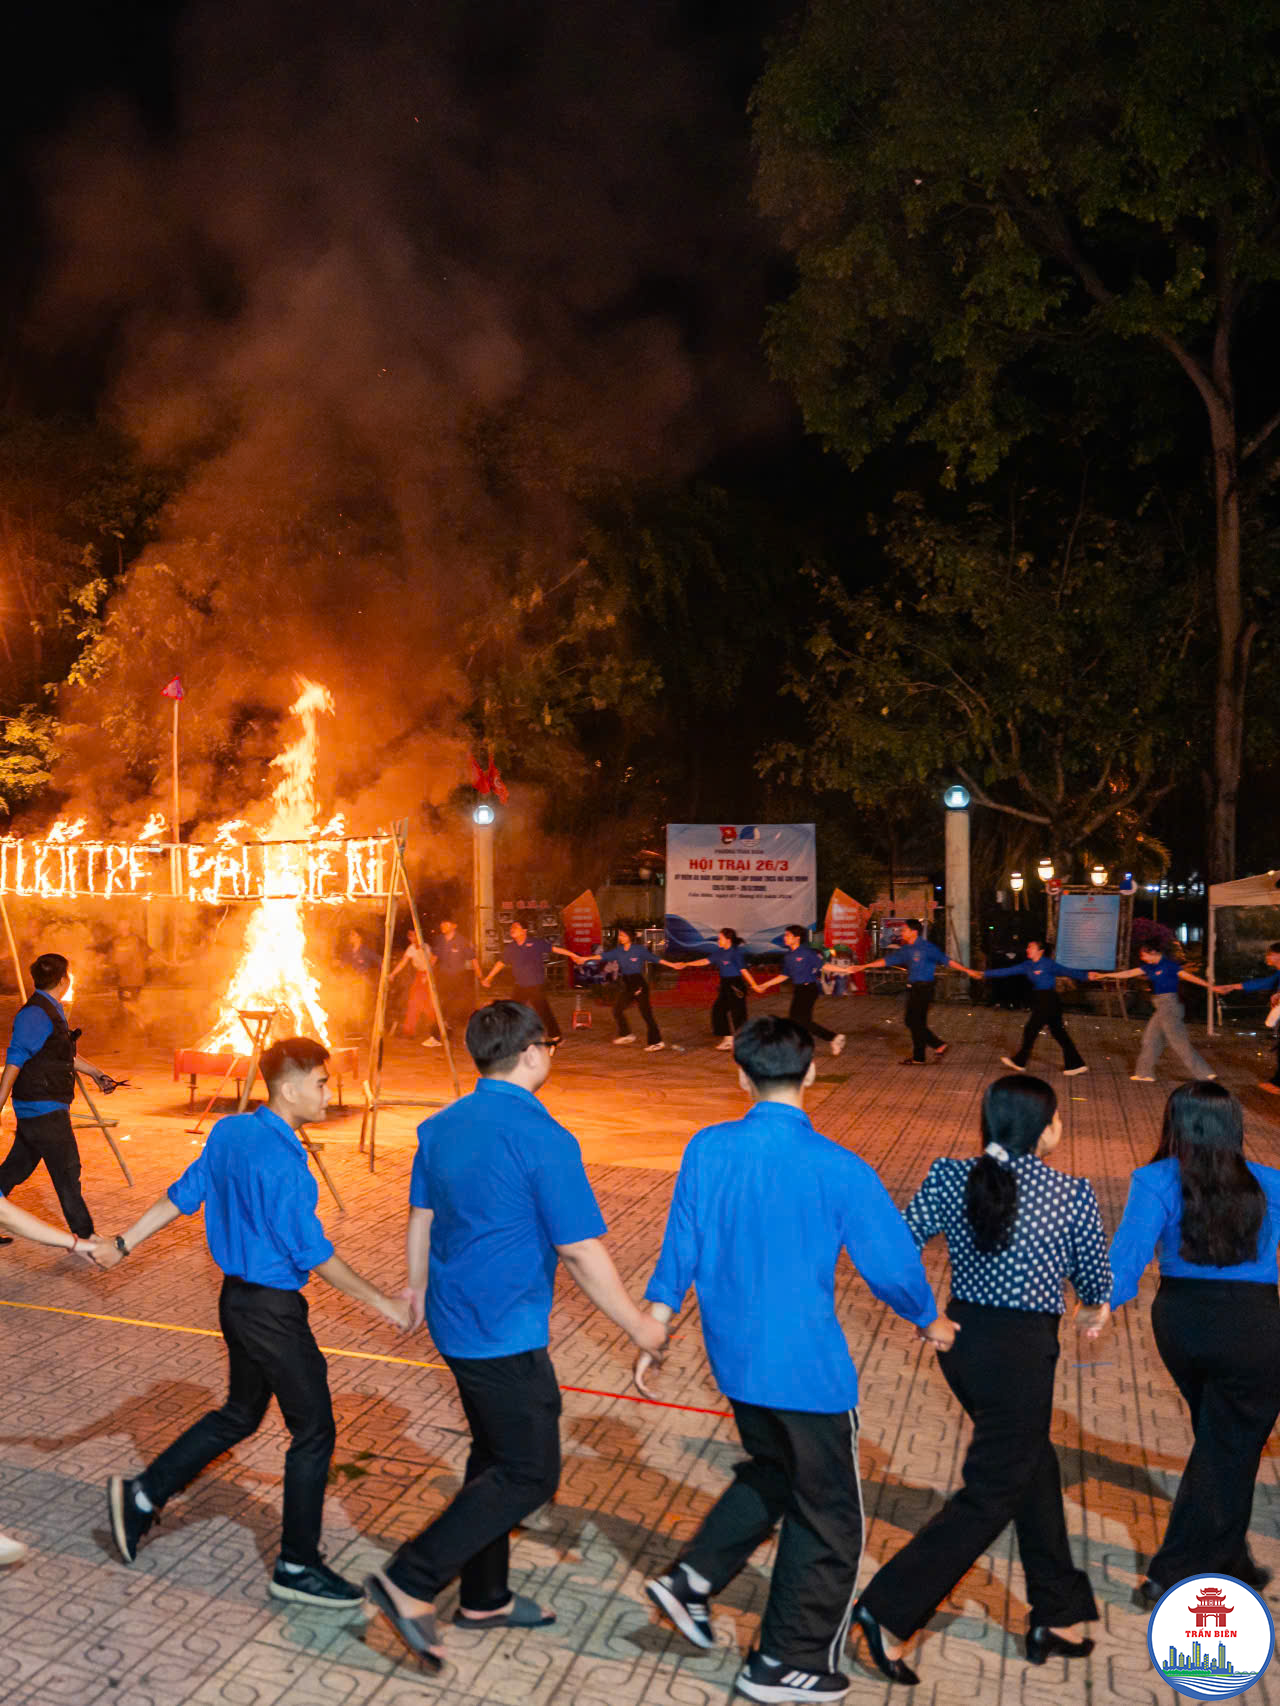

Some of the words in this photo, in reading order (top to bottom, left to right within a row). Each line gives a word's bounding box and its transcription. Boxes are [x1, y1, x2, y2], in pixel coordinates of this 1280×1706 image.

[689, 857, 713, 872] HỘI
[717, 859, 751, 873] TRẠI
[755, 859, 789, 872] 26/3
